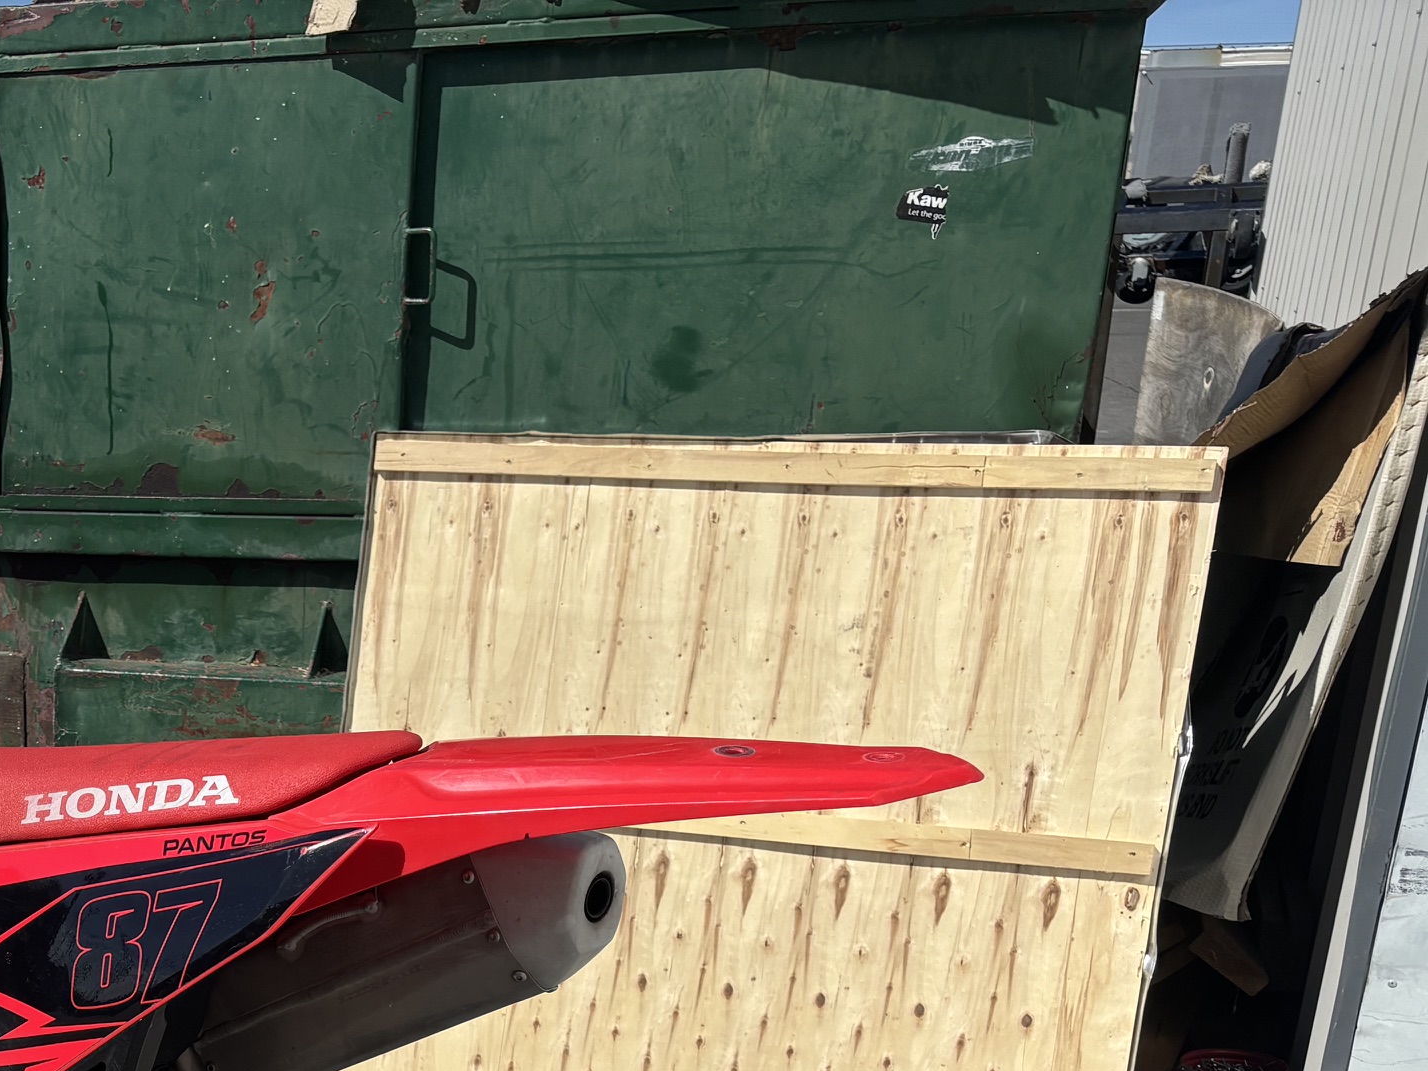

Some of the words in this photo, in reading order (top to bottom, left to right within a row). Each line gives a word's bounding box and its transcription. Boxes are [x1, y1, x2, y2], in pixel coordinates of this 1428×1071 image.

[908, 208, 919, 217] Let
[920, 209, 932, 218] the
[21, 774, 239, 825] HONDA
[163, 830, 267, 856] PANTOS
[71, 879, 223, 1010] 87
